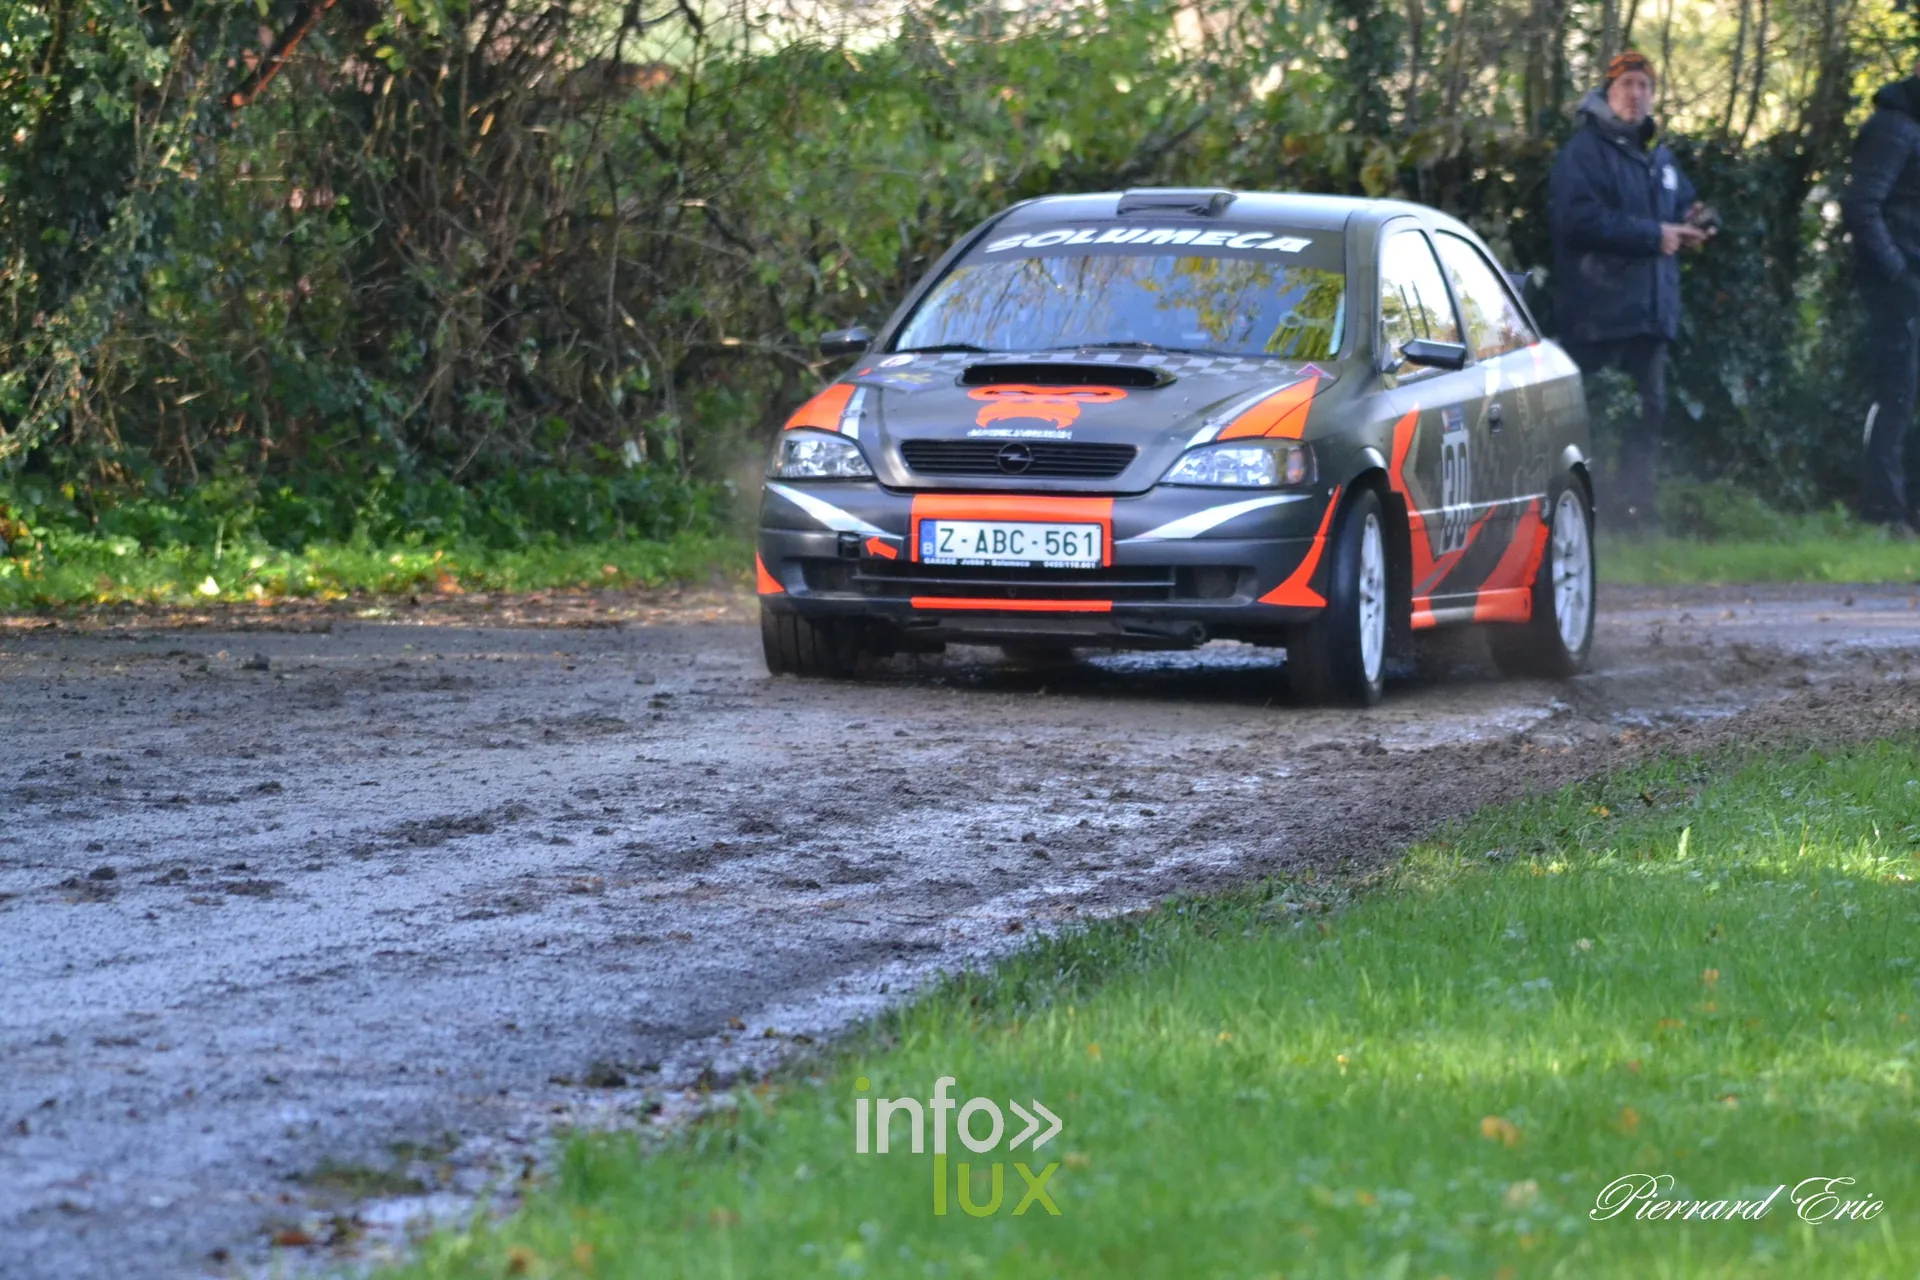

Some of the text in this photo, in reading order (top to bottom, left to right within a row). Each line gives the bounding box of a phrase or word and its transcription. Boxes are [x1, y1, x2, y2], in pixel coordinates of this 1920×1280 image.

[985, 227, 1313, 253] SOLUMECA
[923, 542, 933, 555] B
[939, 528, 1094, 557] Z-ABC-561
[923, 557, 957, 565] GARAGE
